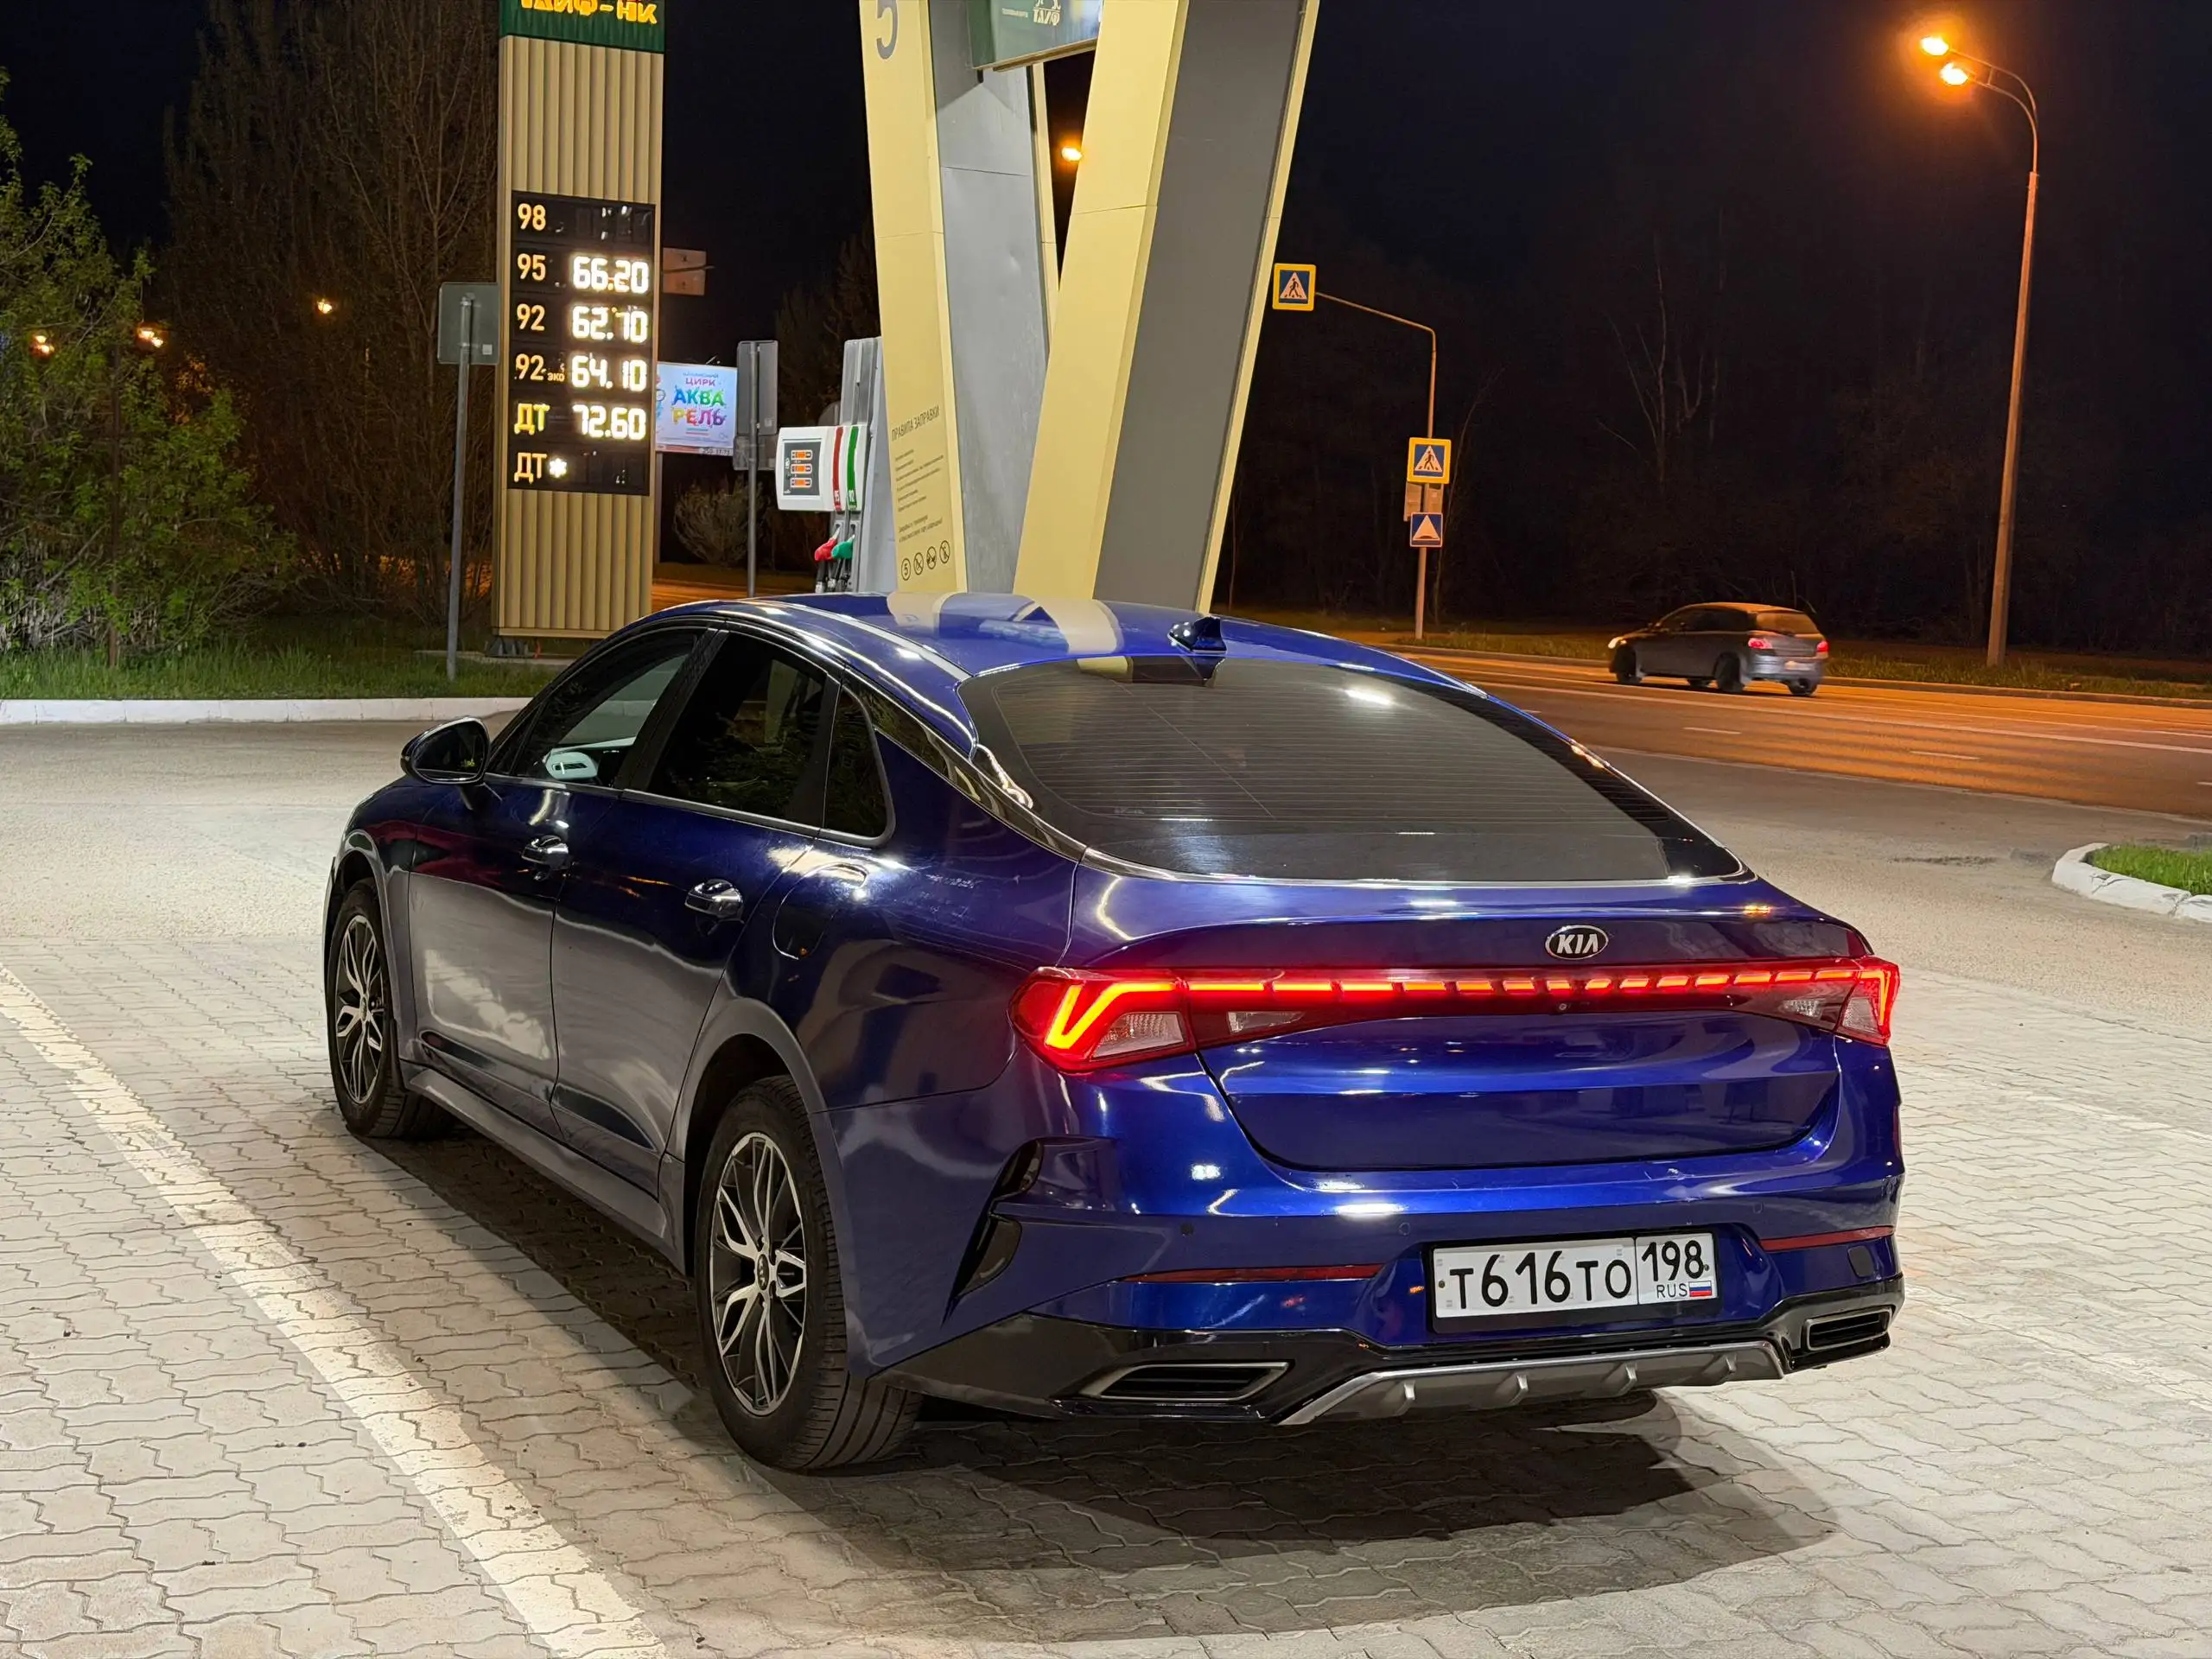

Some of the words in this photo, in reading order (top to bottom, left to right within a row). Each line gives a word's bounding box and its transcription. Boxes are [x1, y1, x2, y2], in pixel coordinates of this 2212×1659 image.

[876, 0, 899, 60] 5
[518, 203, 546, 231] 98
[518, 253, 546, 281] 95
[573, 256, 649, 294] 66.20
[517, 303, 545, 331] 92
[516, 353, 544, 381] 92
[571, 355, 647, 391] 64.10
[685, 378, 715, 386] ЦИРК
[671, 386, 726, 407] АКВА
[514, 404, 550, 435] ДТ
[572, 404, 647, 441] 72.60
[671, 407, 727, 427] РЕЛЬ
[514, 453, 548, 484] ДТ
[1556, 934, 1599, 954] KIA
[1449, 1250, 1632, 1310] Т616ТО
[1641, 1239, 1705, 1282] 198
[1656, 1282, 1688, 1300] RUS
